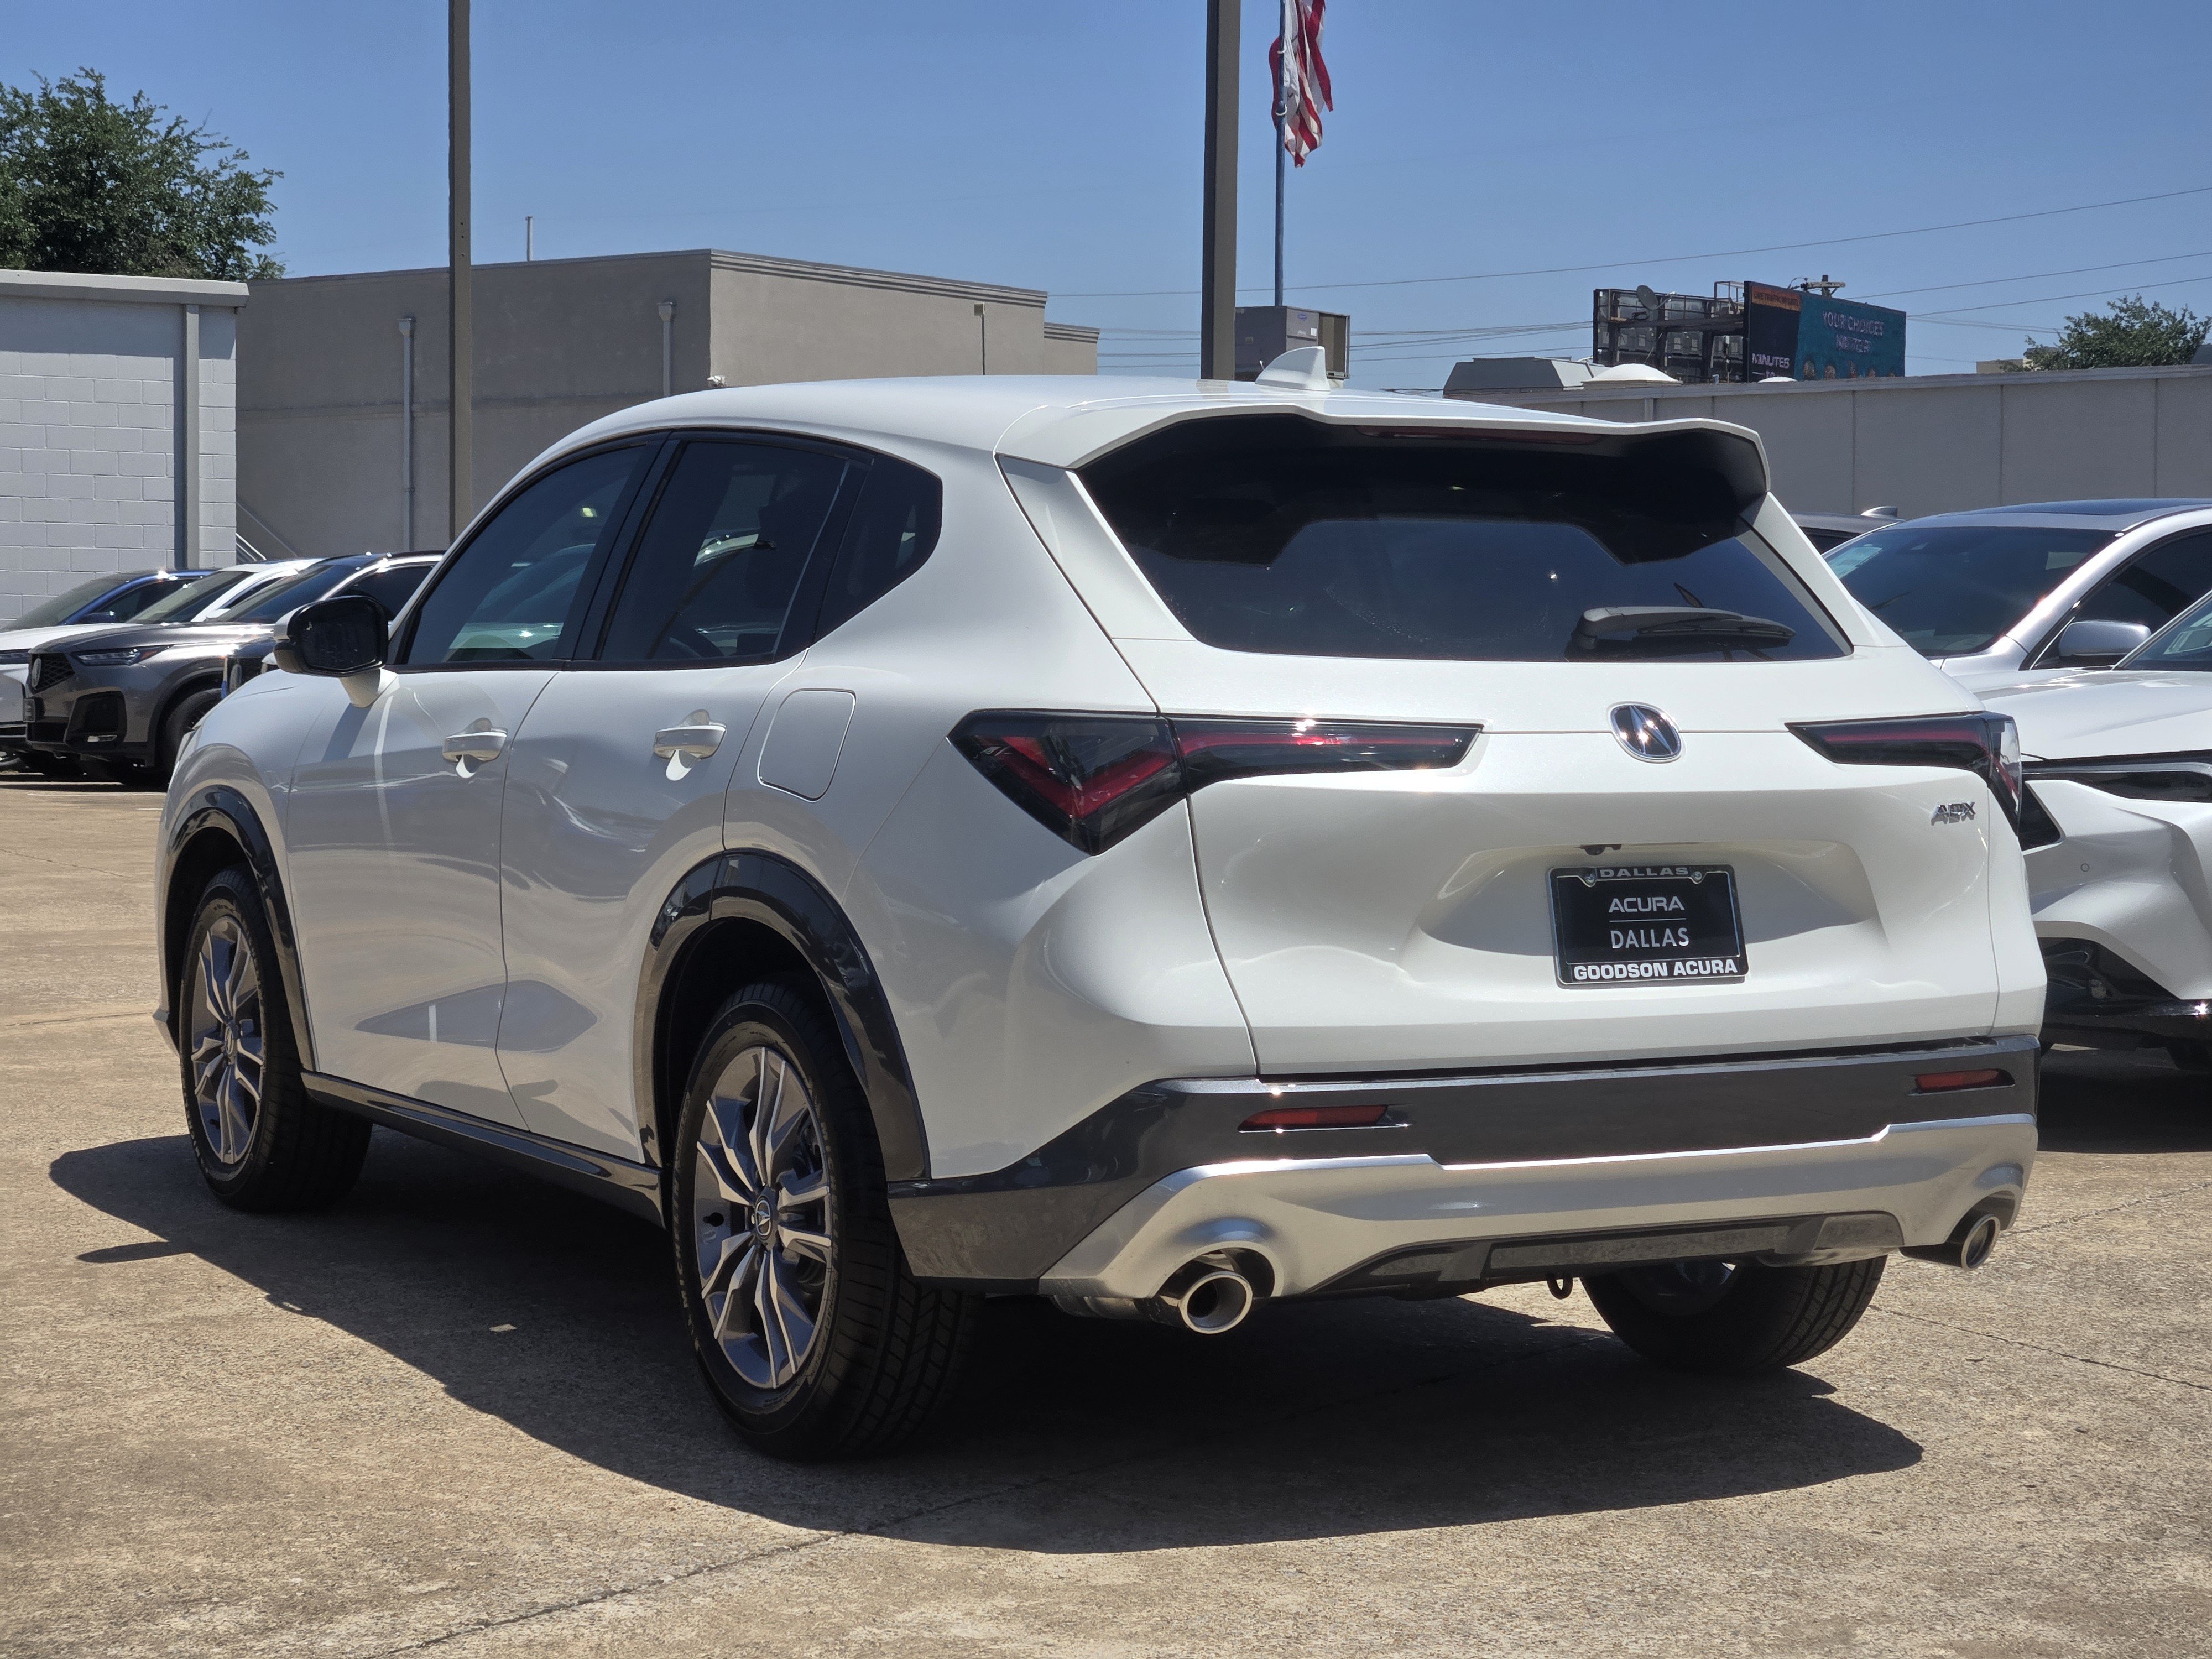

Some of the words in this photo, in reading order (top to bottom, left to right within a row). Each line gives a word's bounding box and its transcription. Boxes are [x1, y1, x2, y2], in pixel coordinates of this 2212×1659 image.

[1822, 310, 1846, 329] YOUR
[1600, 867, 1689, 878] DALLAS
[1609, 896, 1685, 912] ACURA
[1610, 927, 1689, 949] DALLAS
[1574, 962, 1668, 980] GOODSON
[1673, 959, 1738, 976] ACURA
